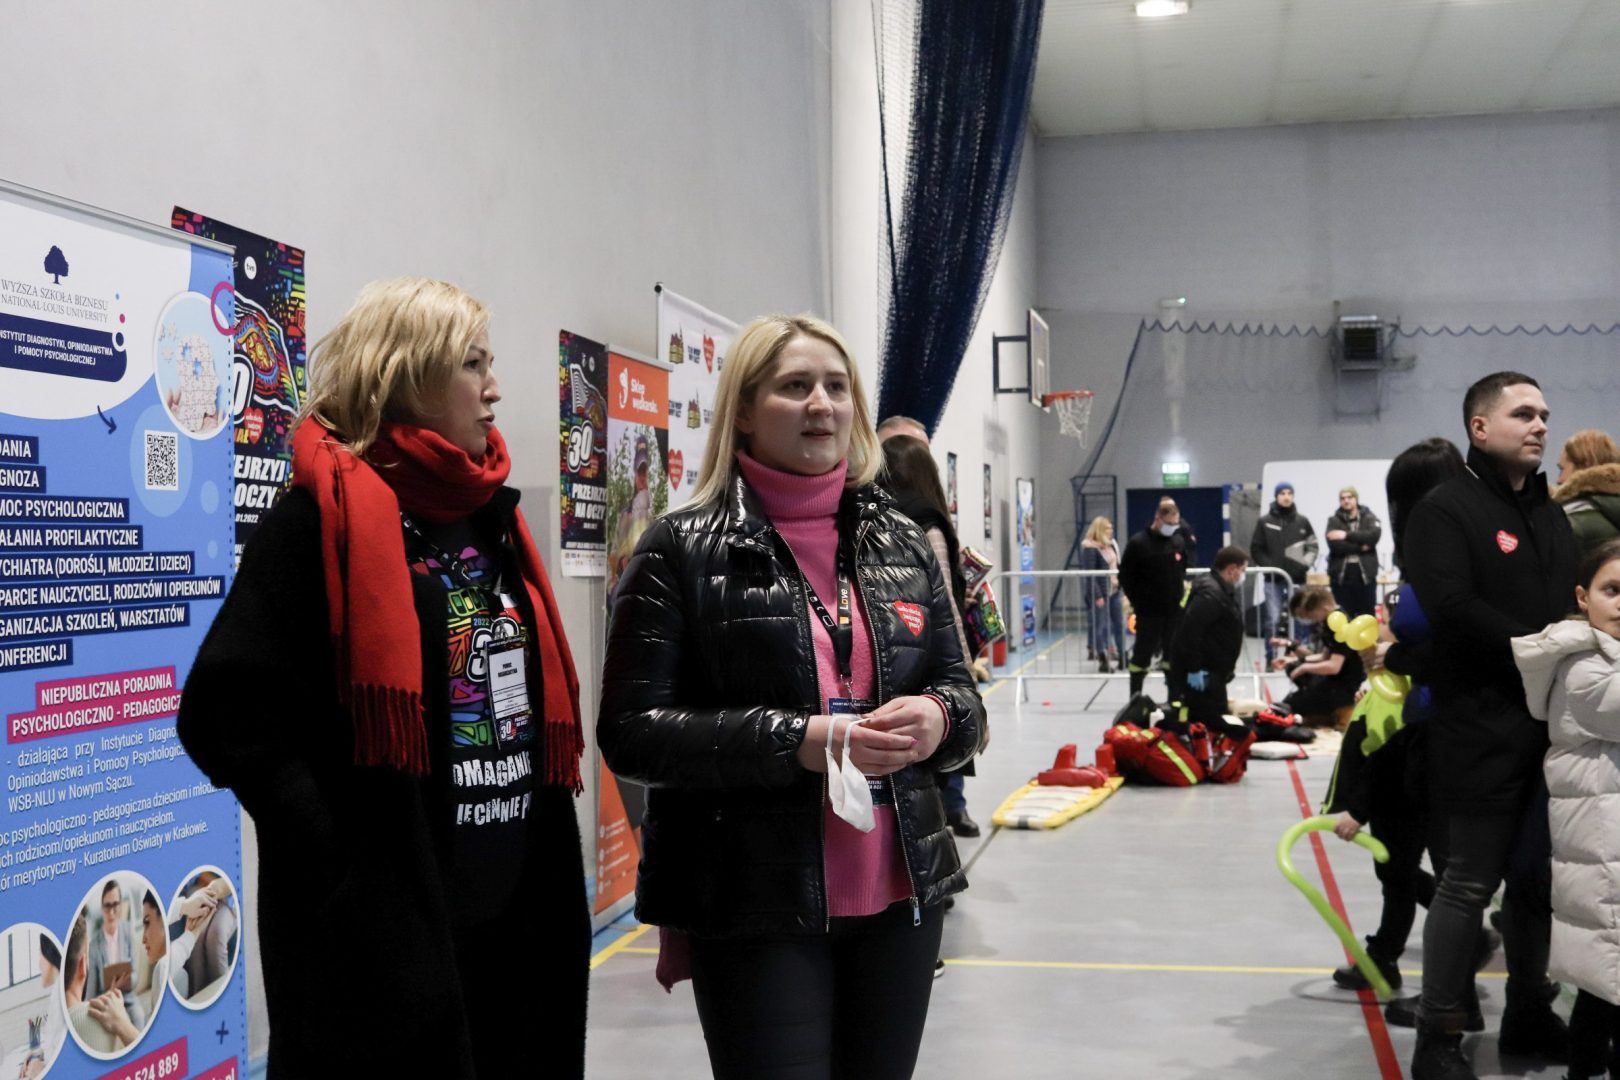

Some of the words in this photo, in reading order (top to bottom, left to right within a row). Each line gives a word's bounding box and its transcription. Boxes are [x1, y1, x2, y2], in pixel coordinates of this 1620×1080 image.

[1, 279, 38, 297] WYŻSZA
[40, 287, 73, 304] SZKOŁA
[74, 294, 109, 311] BIZNESU
[66, 306, 109, 323] UNIVERSITY
[17, 345, 44, 358] POMOCY
[44, 350, 96, 366] PSYCHOLOGICZNEJ
[67, 340, 114, 356] OPINIODAWSTWA
[0, 439, 32, 458] ANIA
[568, 420, 593, 472] 30
[234, 454, 286, 484] EJRZYJ
[25, 499, 125, 518] PSYCHOLOGICZNA
[234, 482, 278, 509] OCZY
[575, 501, 586, 518] NA
[45, 529, 139, 546] PROFILAKTYCZNE
[0, 558, 54, 577] CHIATRA
[55, 553, 107, 579] (DOROŚLI,
[108, 553, 154, 573] MŁODZIEŻ
[155, 556, 159, 571] I
[160, 554, 191, 574] DZIECI)
[40, 584, 112, 604] NAUCZYCIELI,
[114, 579, 163, 601] RODZICÓW
[164, 582, 168, 597] I
[169, 576, 221, 597] OPIEKUNÓW
[66, 608, 118, 632] SZKOLEŃ,
[120, 604, 185, 628] WARSZTATÓW
[473, 617, 491, 627] 2022
[41, 680, 121, 706] NIEPUBLICZNA
[123, 673, 173, 695] PORADNIA
[12, 705, 114, 737] PSYCHOLOGICZNO
[18, 745, 69, 768] działająca
[75, 741, 95, 760] przy
[101, 730, 144, 752] Instytucie
[7, 764, 84, 794] Opiniodawstwa
[94, 754, 130, 774] Pomocy
[8, 787, 56, 814] WSB-NLU
[58, 789, 67, 802] w
[69, 781, 104, 800] Nowym
[105, 775, 136, 794] Sączu.
[12, 814, 87, 848] psychologiczno
[93, 797, 152, 828] pedagogiczna
[152, 786, 188, 809] dzieciom
[15, 827, 114, 866] rodzicom/opiekunom
[120, 810, 176, 835] nauczycielom.
[13, 858, 77, 888] merytoryczny
[83, 842, 131, 867] Kuratorium
[131, 834, 163, 853] Oświaty
[164, 829, 172, 843] w
[172, 819, 209, 841] Krakowie.
[158, 1052, 179, 1078] 889
